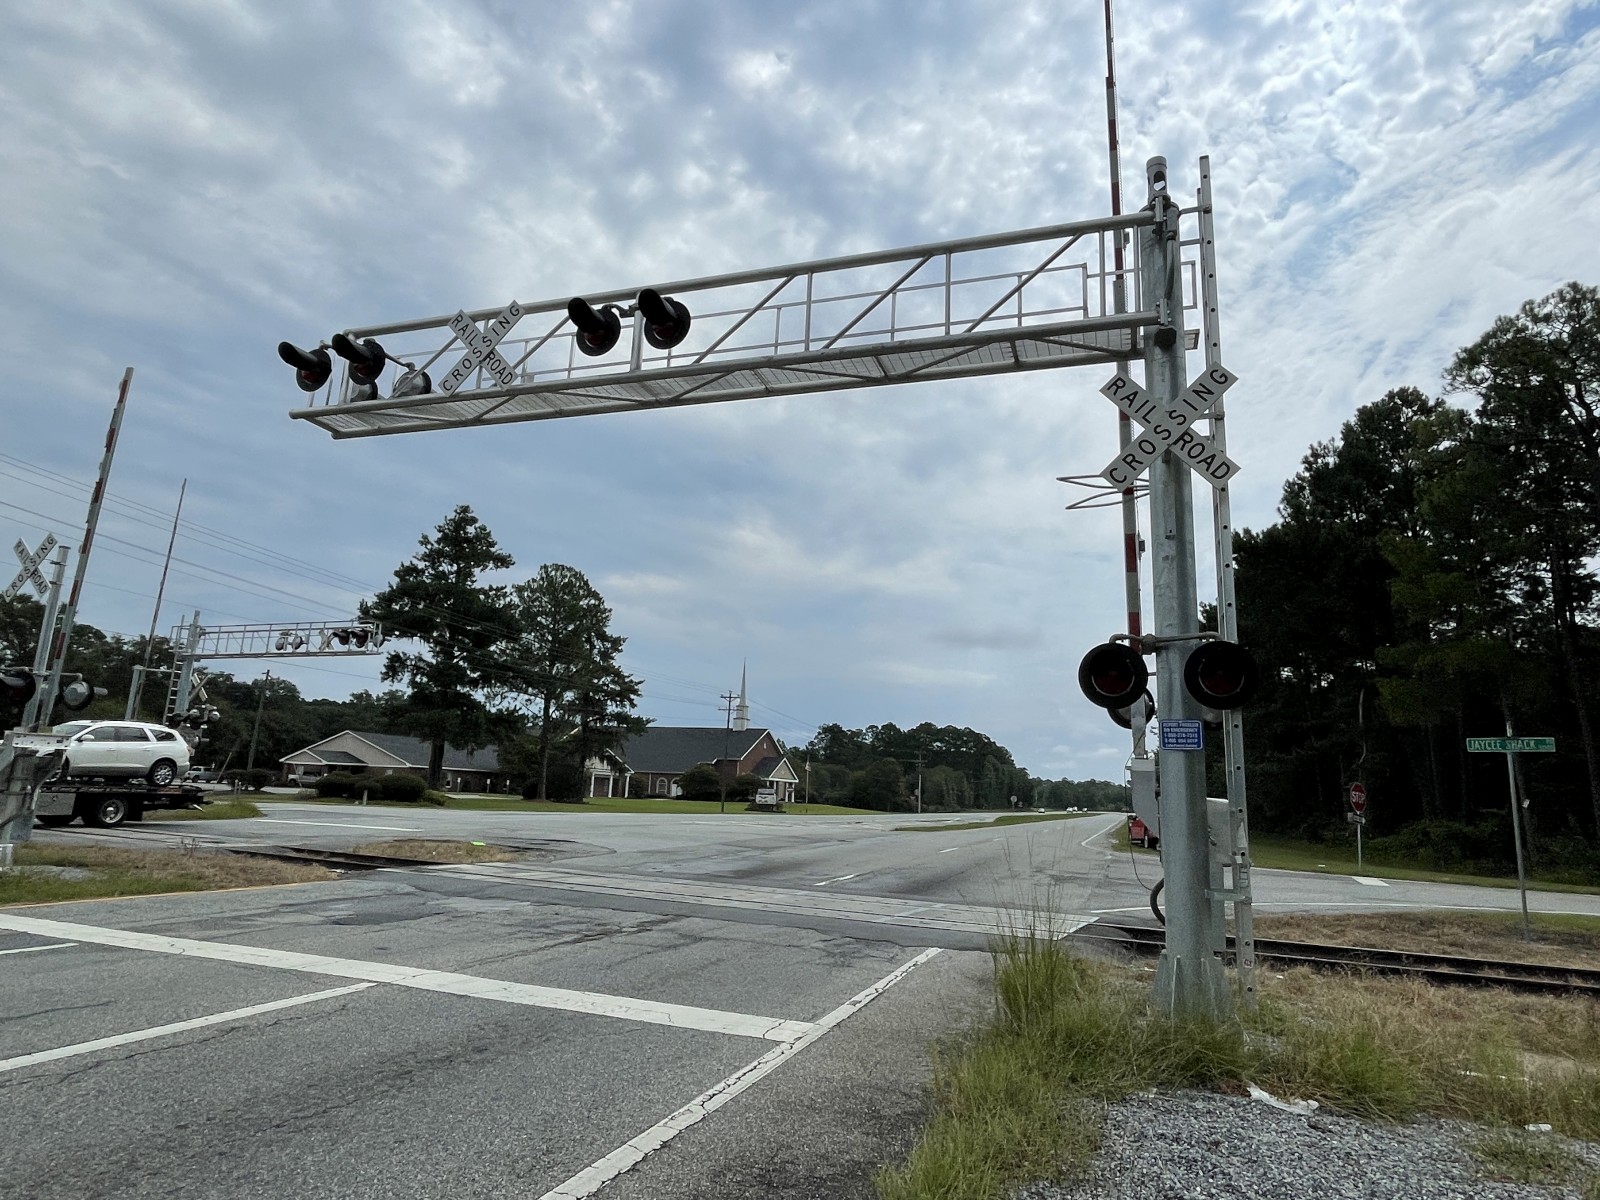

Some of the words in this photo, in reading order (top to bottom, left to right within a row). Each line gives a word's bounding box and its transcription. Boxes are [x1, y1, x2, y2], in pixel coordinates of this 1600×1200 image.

[442, 305, 520, 391] CROSSING
[1109, 368, 1229, 484] CROSSING
[5, 536, 54, 598] CROSSING
[1470, 740, 1502, 750] JAYCEE
[1505, 739, 1536, 750] SHACK
[1351, 791, 1365, 804] STOP
